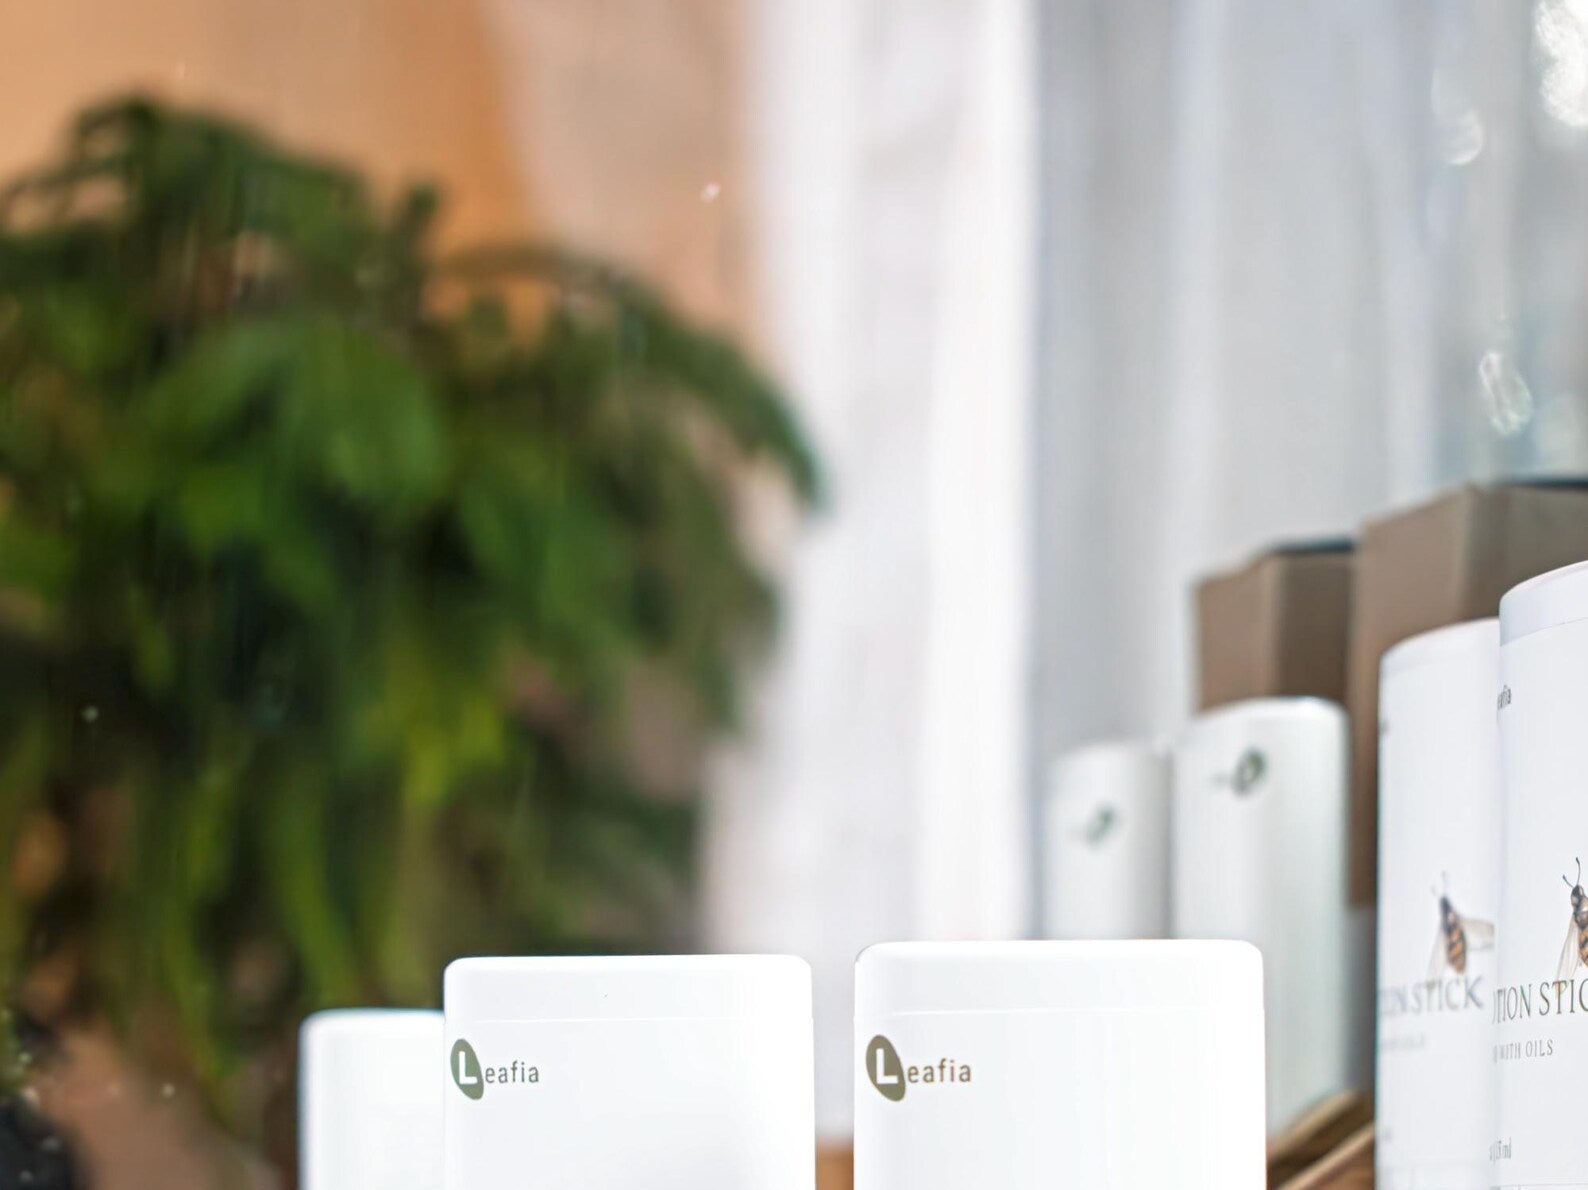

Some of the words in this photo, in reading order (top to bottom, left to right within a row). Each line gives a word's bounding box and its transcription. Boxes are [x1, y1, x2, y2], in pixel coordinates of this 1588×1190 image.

[1411, 975, 1483, 1014] STICK
[1492, 984, 1532, 1024] TION
[454, 1047, 541, 1089] Leafia
[870, 1045, 973, 1089] Leafia
[1525, 1039, 1553, 1058] OILS
